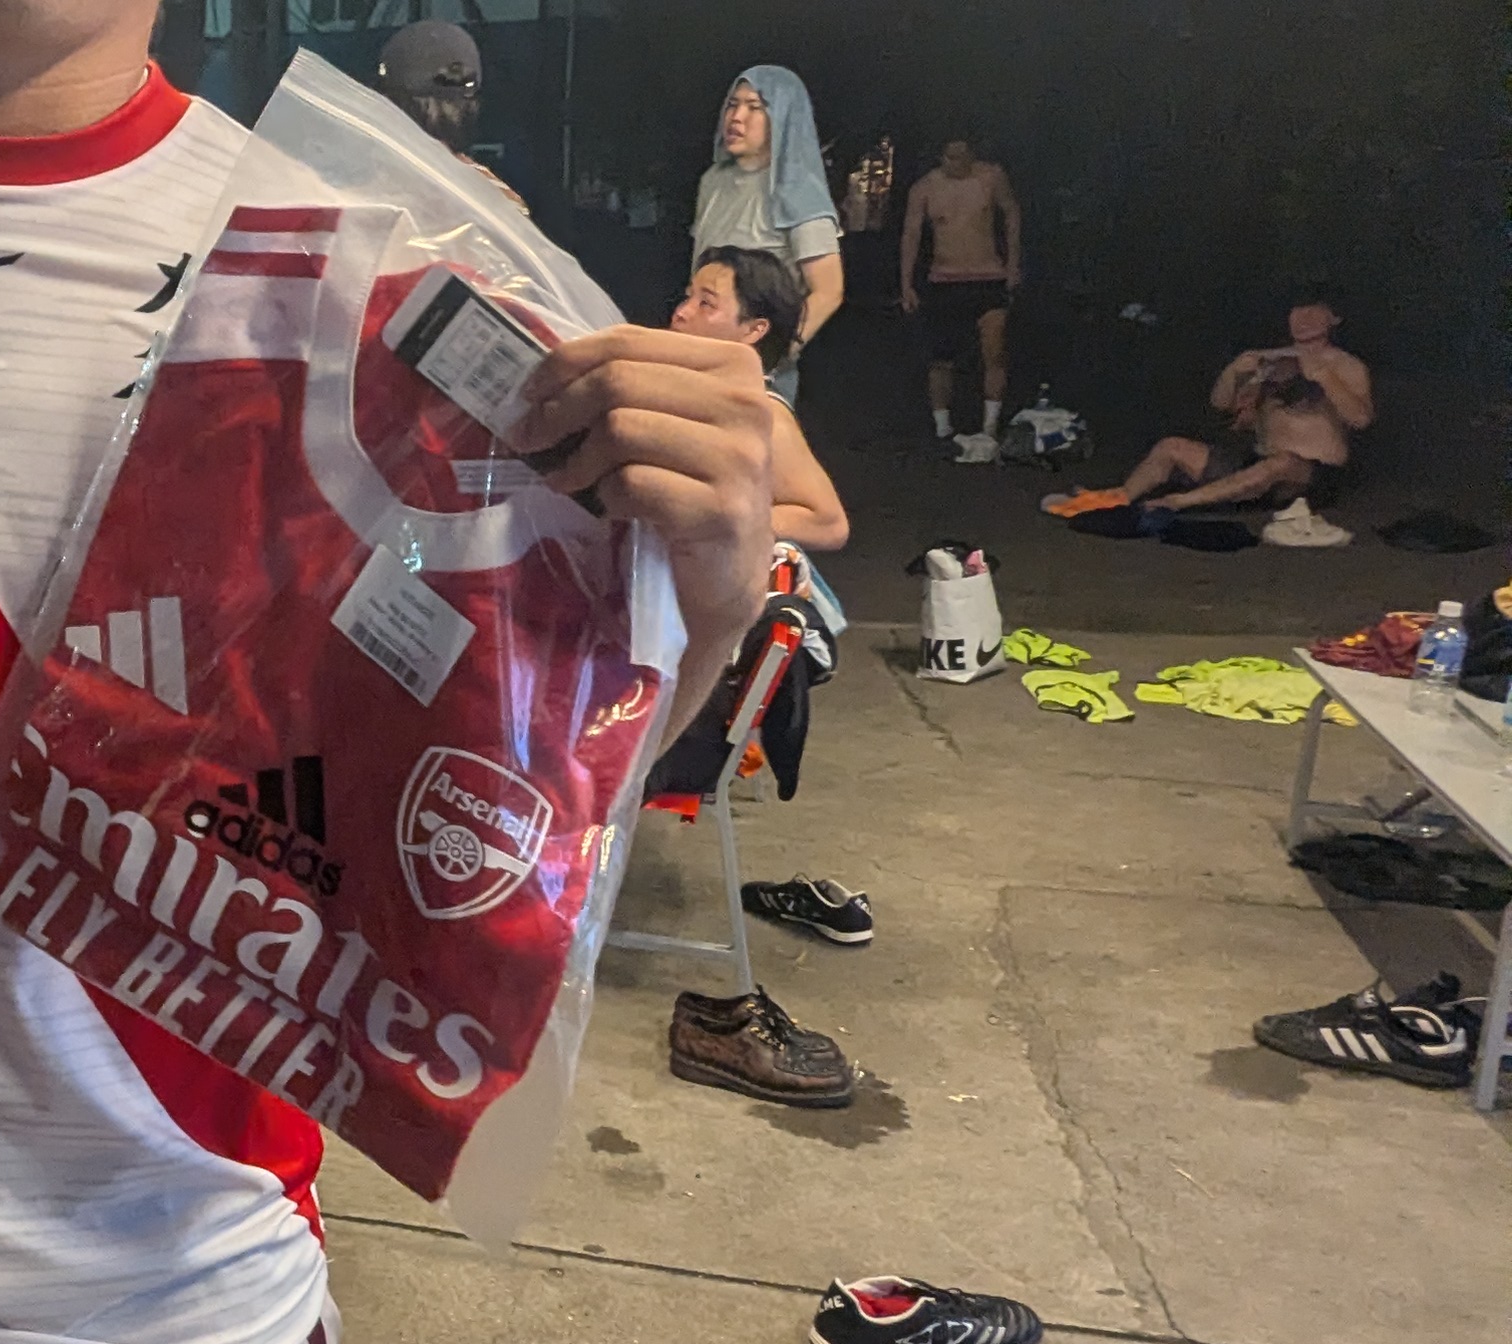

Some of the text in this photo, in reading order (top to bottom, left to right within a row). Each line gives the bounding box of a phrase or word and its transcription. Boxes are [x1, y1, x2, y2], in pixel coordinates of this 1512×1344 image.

[184, 799, 347, 898] adidas
[430, 772, 529, 840] Arsenal
[112, 929, 365, 1135] BETTER
